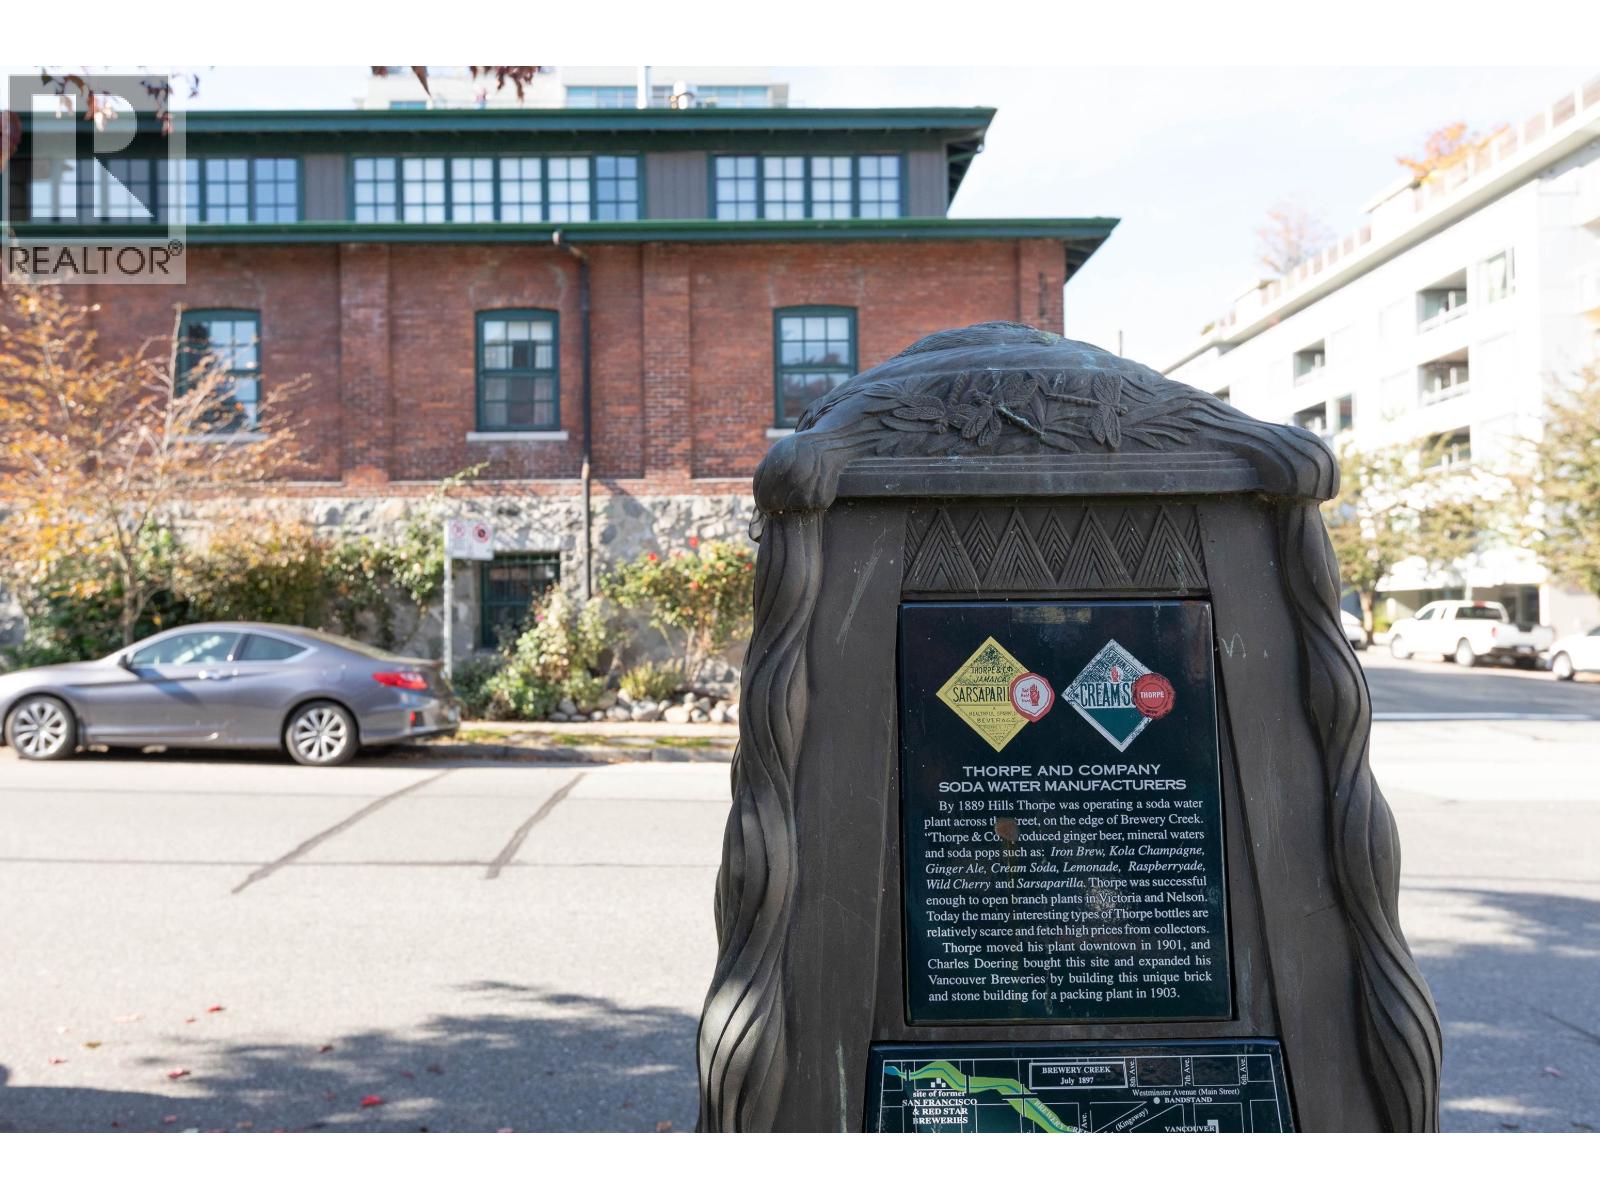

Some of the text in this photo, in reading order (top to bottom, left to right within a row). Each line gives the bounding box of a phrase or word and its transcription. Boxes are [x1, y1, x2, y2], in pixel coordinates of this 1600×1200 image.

[953, 686, 1010, 702] SARSAPARIL
[1080, 682, 1118, 707] CREAM
[962, 764, 1161, 777] THORPE AND COMPANY
[939, 779, 1186, 792] SODA WATER MANUFACTURERS
[939, 800, 954, 814] By
[959, 800, 984, 811] 1889
[988, 800, 1014, 810] Hills
[1016, 800, 1056, 812] Thorpe
[1059, 802, 1080, 810] was
[1082, 798, 1134, 812] operating
[1146, 798, 1170, 808] soda
[1173, 800, 1204, 808] water
[924, 816, 951, 830] plant
[954, 818, 987, 826] across
[1043, 818, 1057, 826] on
[1060, 815, 1076, 825] the
[1078, 814, 1104, 828] edge
[1106, 814, 1119, 824] of
[1120, 814, 1166, 827] Brewery
[1168, 813, 1204, 824] Creek.
[971, 832, 982, 842] &
[1012, 831, 1061, 844] roduced
[1063, 830, 1098, 844] ginger
[1099, 830, 1125, 841] beer,
[1127, 829, 1168, 840] mineral
[1170, 830, 1205, 839] waters
[925, 844, 1204, 860] and soda pops such as: Iron Brew, Kola Champagne,
[926, 860, 1206, 876] Ginger Ale, Cream Soda, Lemonade, Raspberryade,
[926, 876, 1207, 891] Wild Cherry and Sarsaparilla. Thorpe was successful
[926, 890, 1208, 908] enough to open branch plants in Victoria and Nelson.
[926, 908, 1209, 924] Today the many interesting types of Thorpe bottles are
[927, 923, 1210, 939] relatively scarce and fetch high prices from collectors.
[942, 938, 1211, 956] Thorpe moved his plant downtown in 1901, and
[928, 955, 1212, 971] Charles Doering bought this site and expanded his
[928, 971, 1212, 986] Vancouver Breweries by building this unique brick
[928, 987, 1180, 1003] and stone building for a packing plant in 1903.
[1115, 1108, 1149, 1131] (Kingsway)
